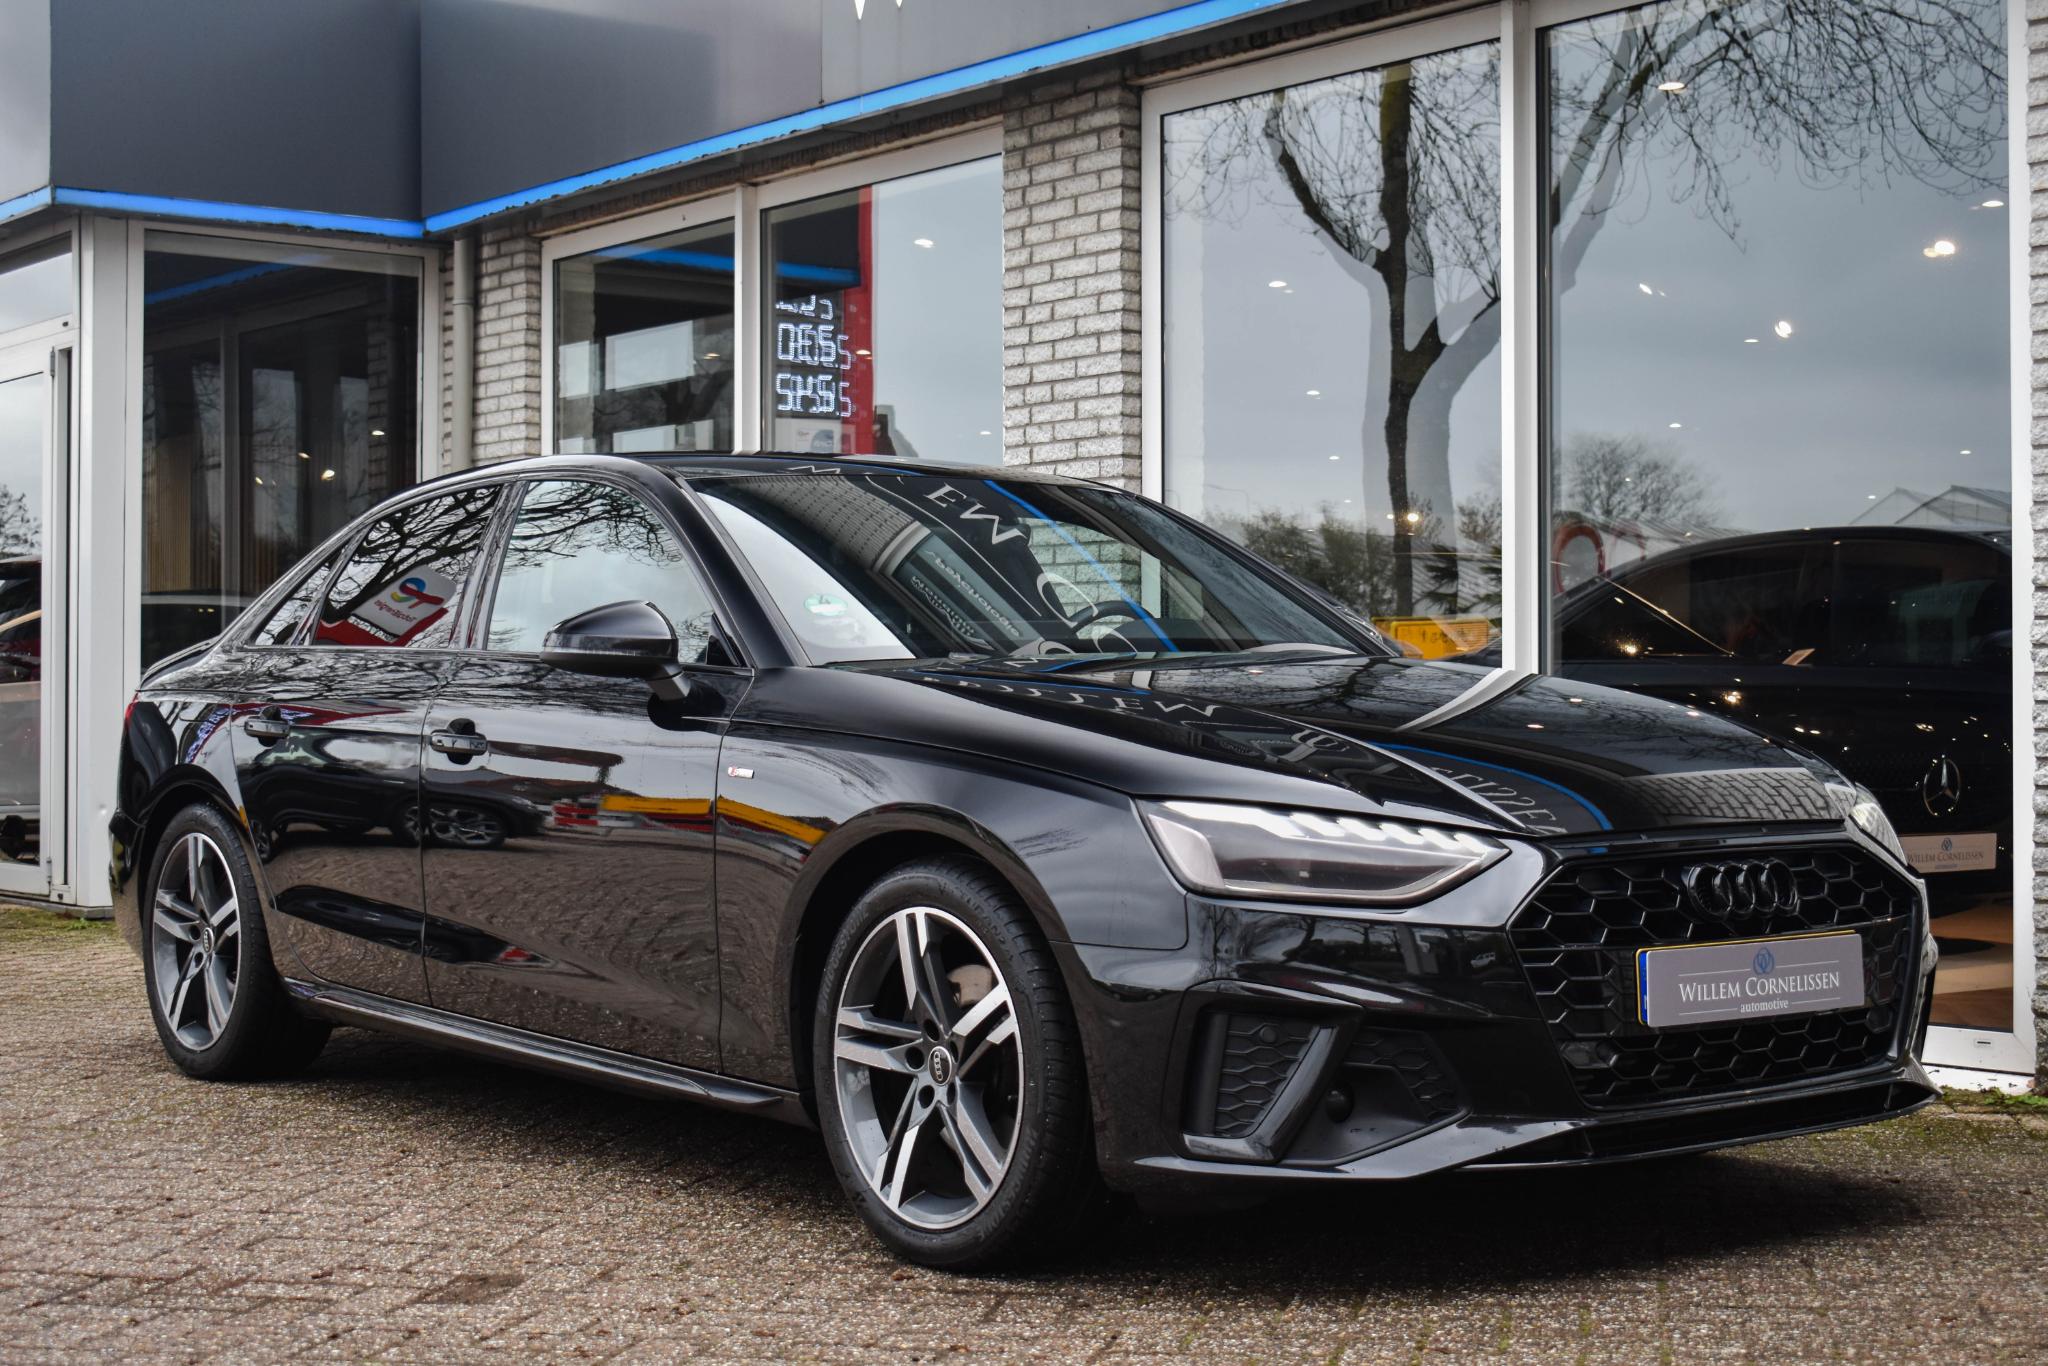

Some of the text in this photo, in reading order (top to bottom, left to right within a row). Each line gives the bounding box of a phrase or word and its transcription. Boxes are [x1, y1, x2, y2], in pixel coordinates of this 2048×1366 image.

[1679, 971, 1840, 1003] WILLEM CORNELISSEN
[1740, 998, 1789, 1013] automotive
